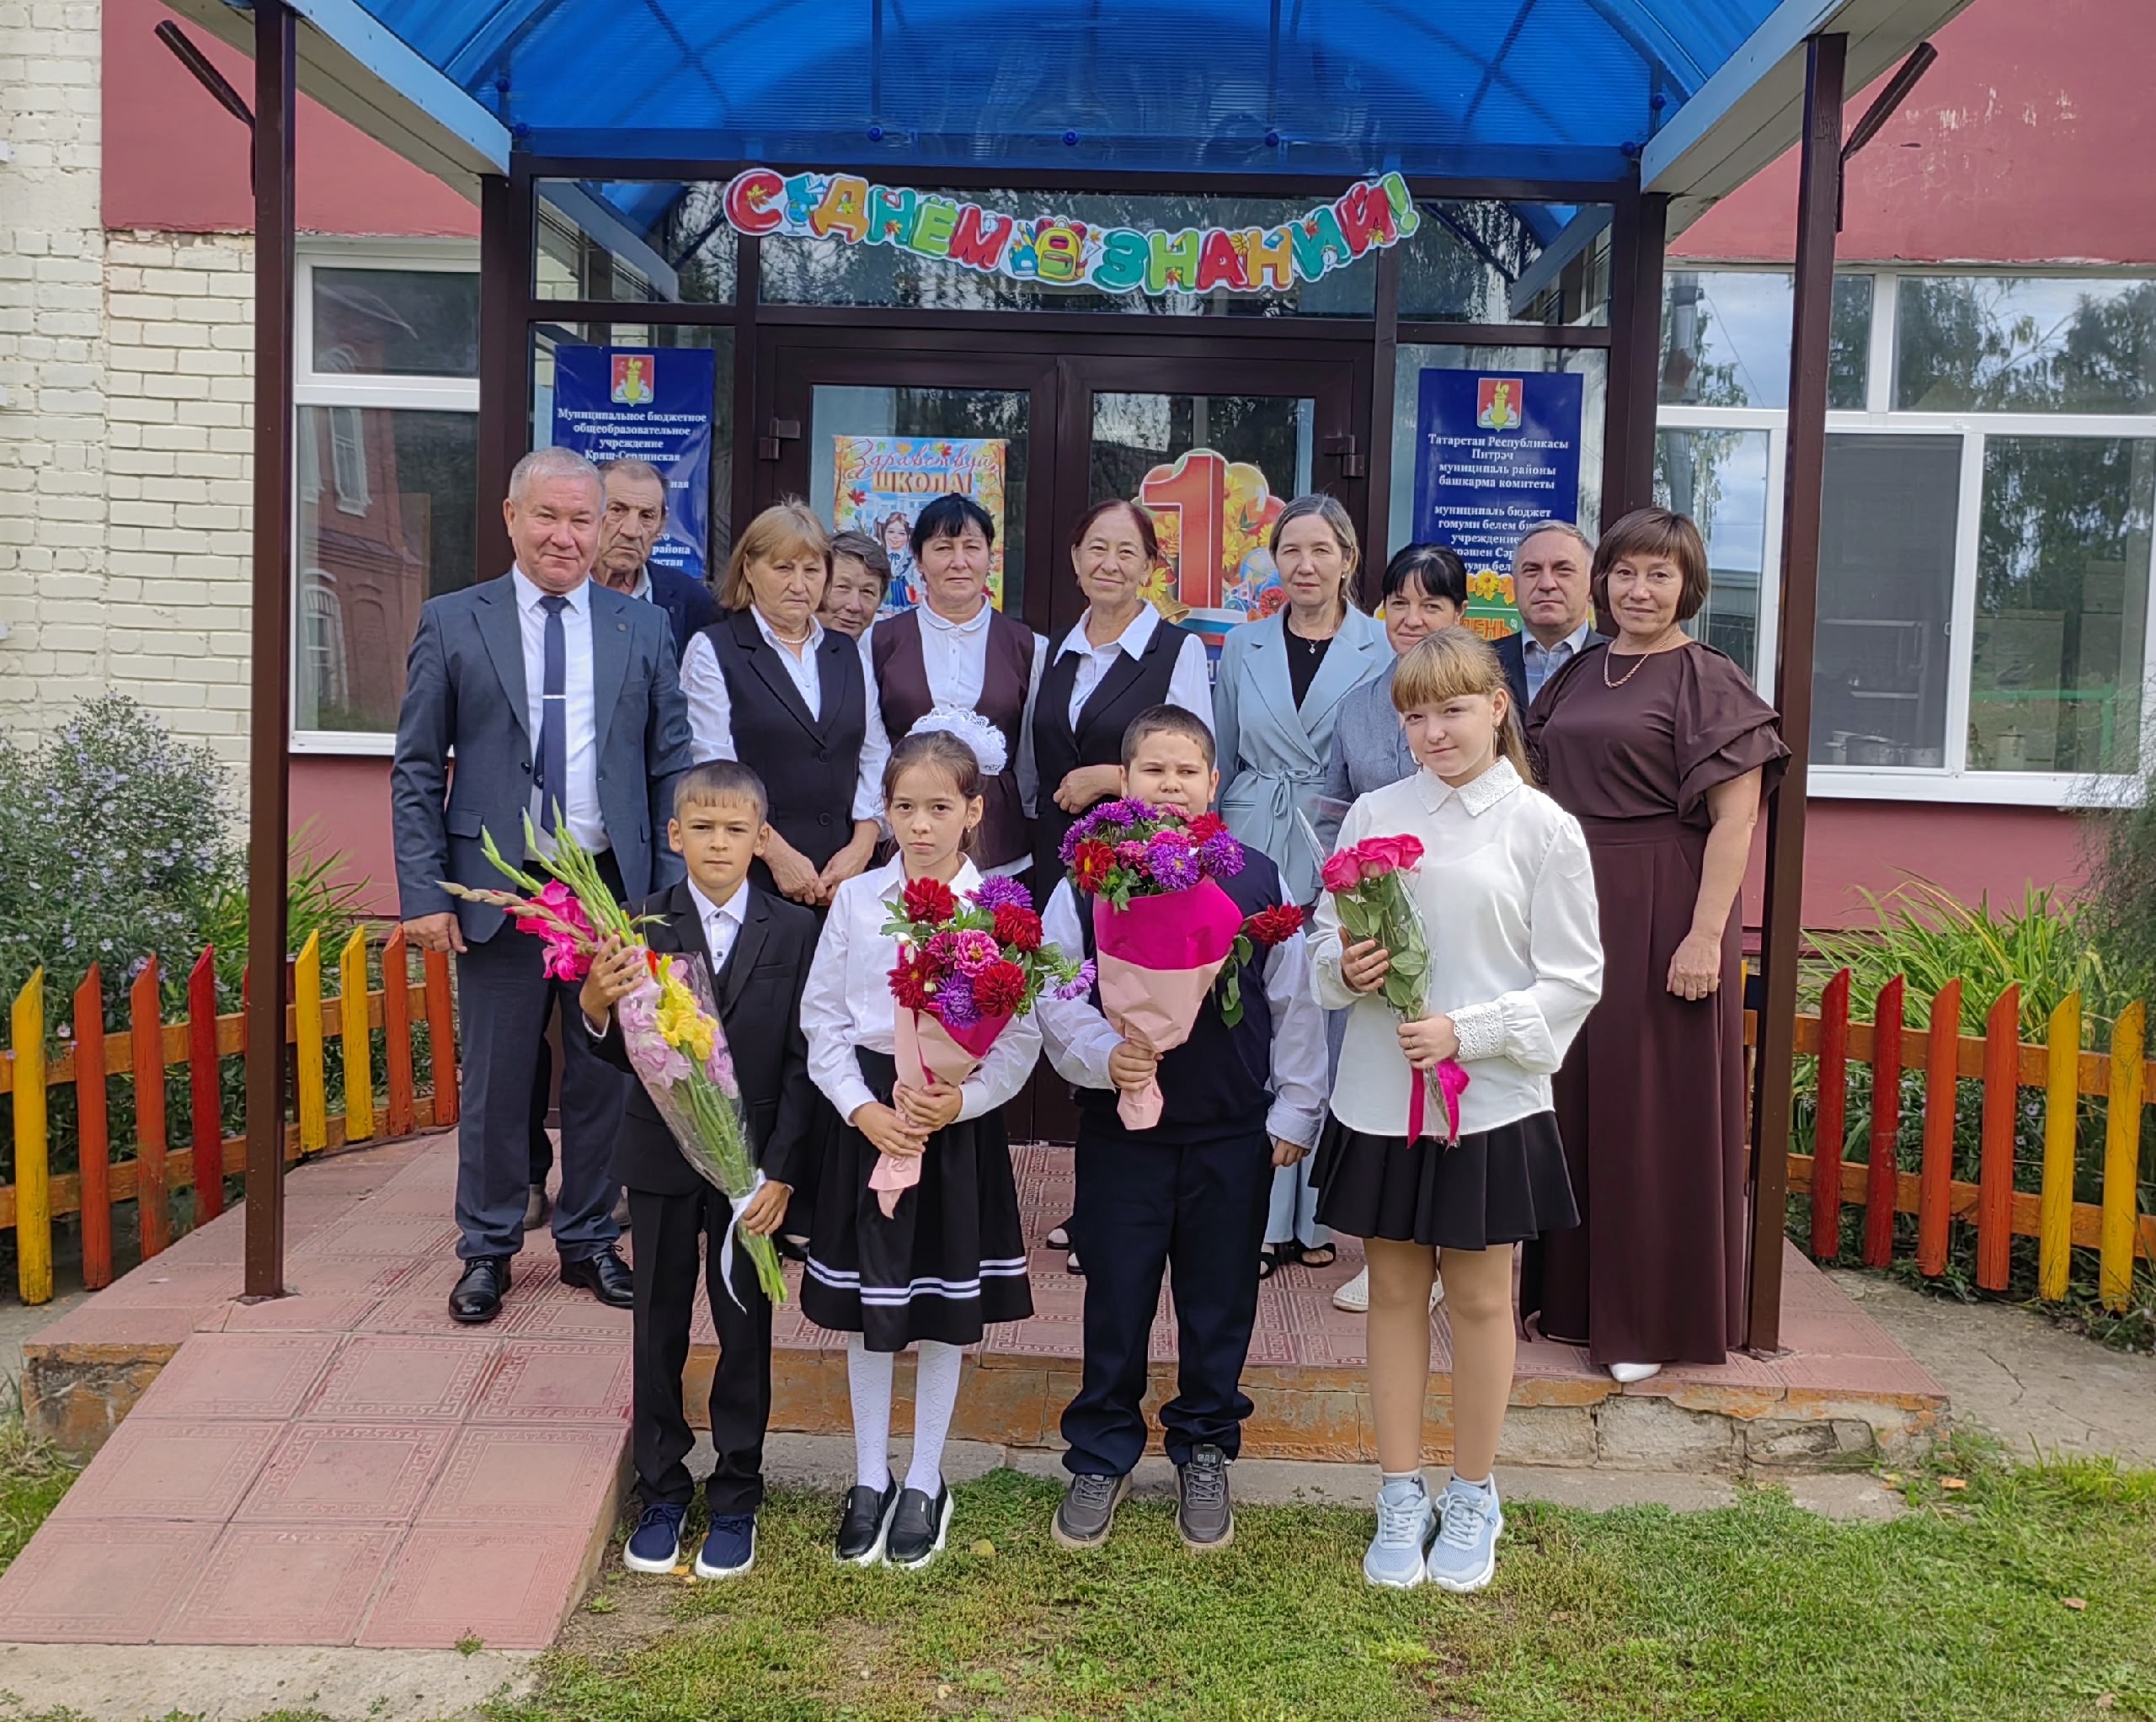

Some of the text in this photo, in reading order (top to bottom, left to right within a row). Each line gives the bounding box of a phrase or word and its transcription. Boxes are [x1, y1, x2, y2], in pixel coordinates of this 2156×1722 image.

[727, 172, 1418, 293] С ДНЁМ ЗНАНИЙ!
[558, 407, 707, 423] Муниципальное бюджетное
[573, 423, 691, 436] общеобразовательное
[599, 439, 664, 450] учреждение
[1428, 434, 1569, 450] Татарстан Республикасы
[1471, 448, 1514, 461] Питрәч
[1438, 462, 1556, 477] муниципаль районы
[1438, 475, 1556, 489] башкарма комитеты
[1434, 505, 1552, 519] муниципаль бюджет
[1438, 519, 1481, 530] гомуми
[1482, 519, 1517, 530] белем
[1142, 455, 1225, 609] 1
[651, 543, 691, 556] района
[1492, 560, 1513, 572] бел
